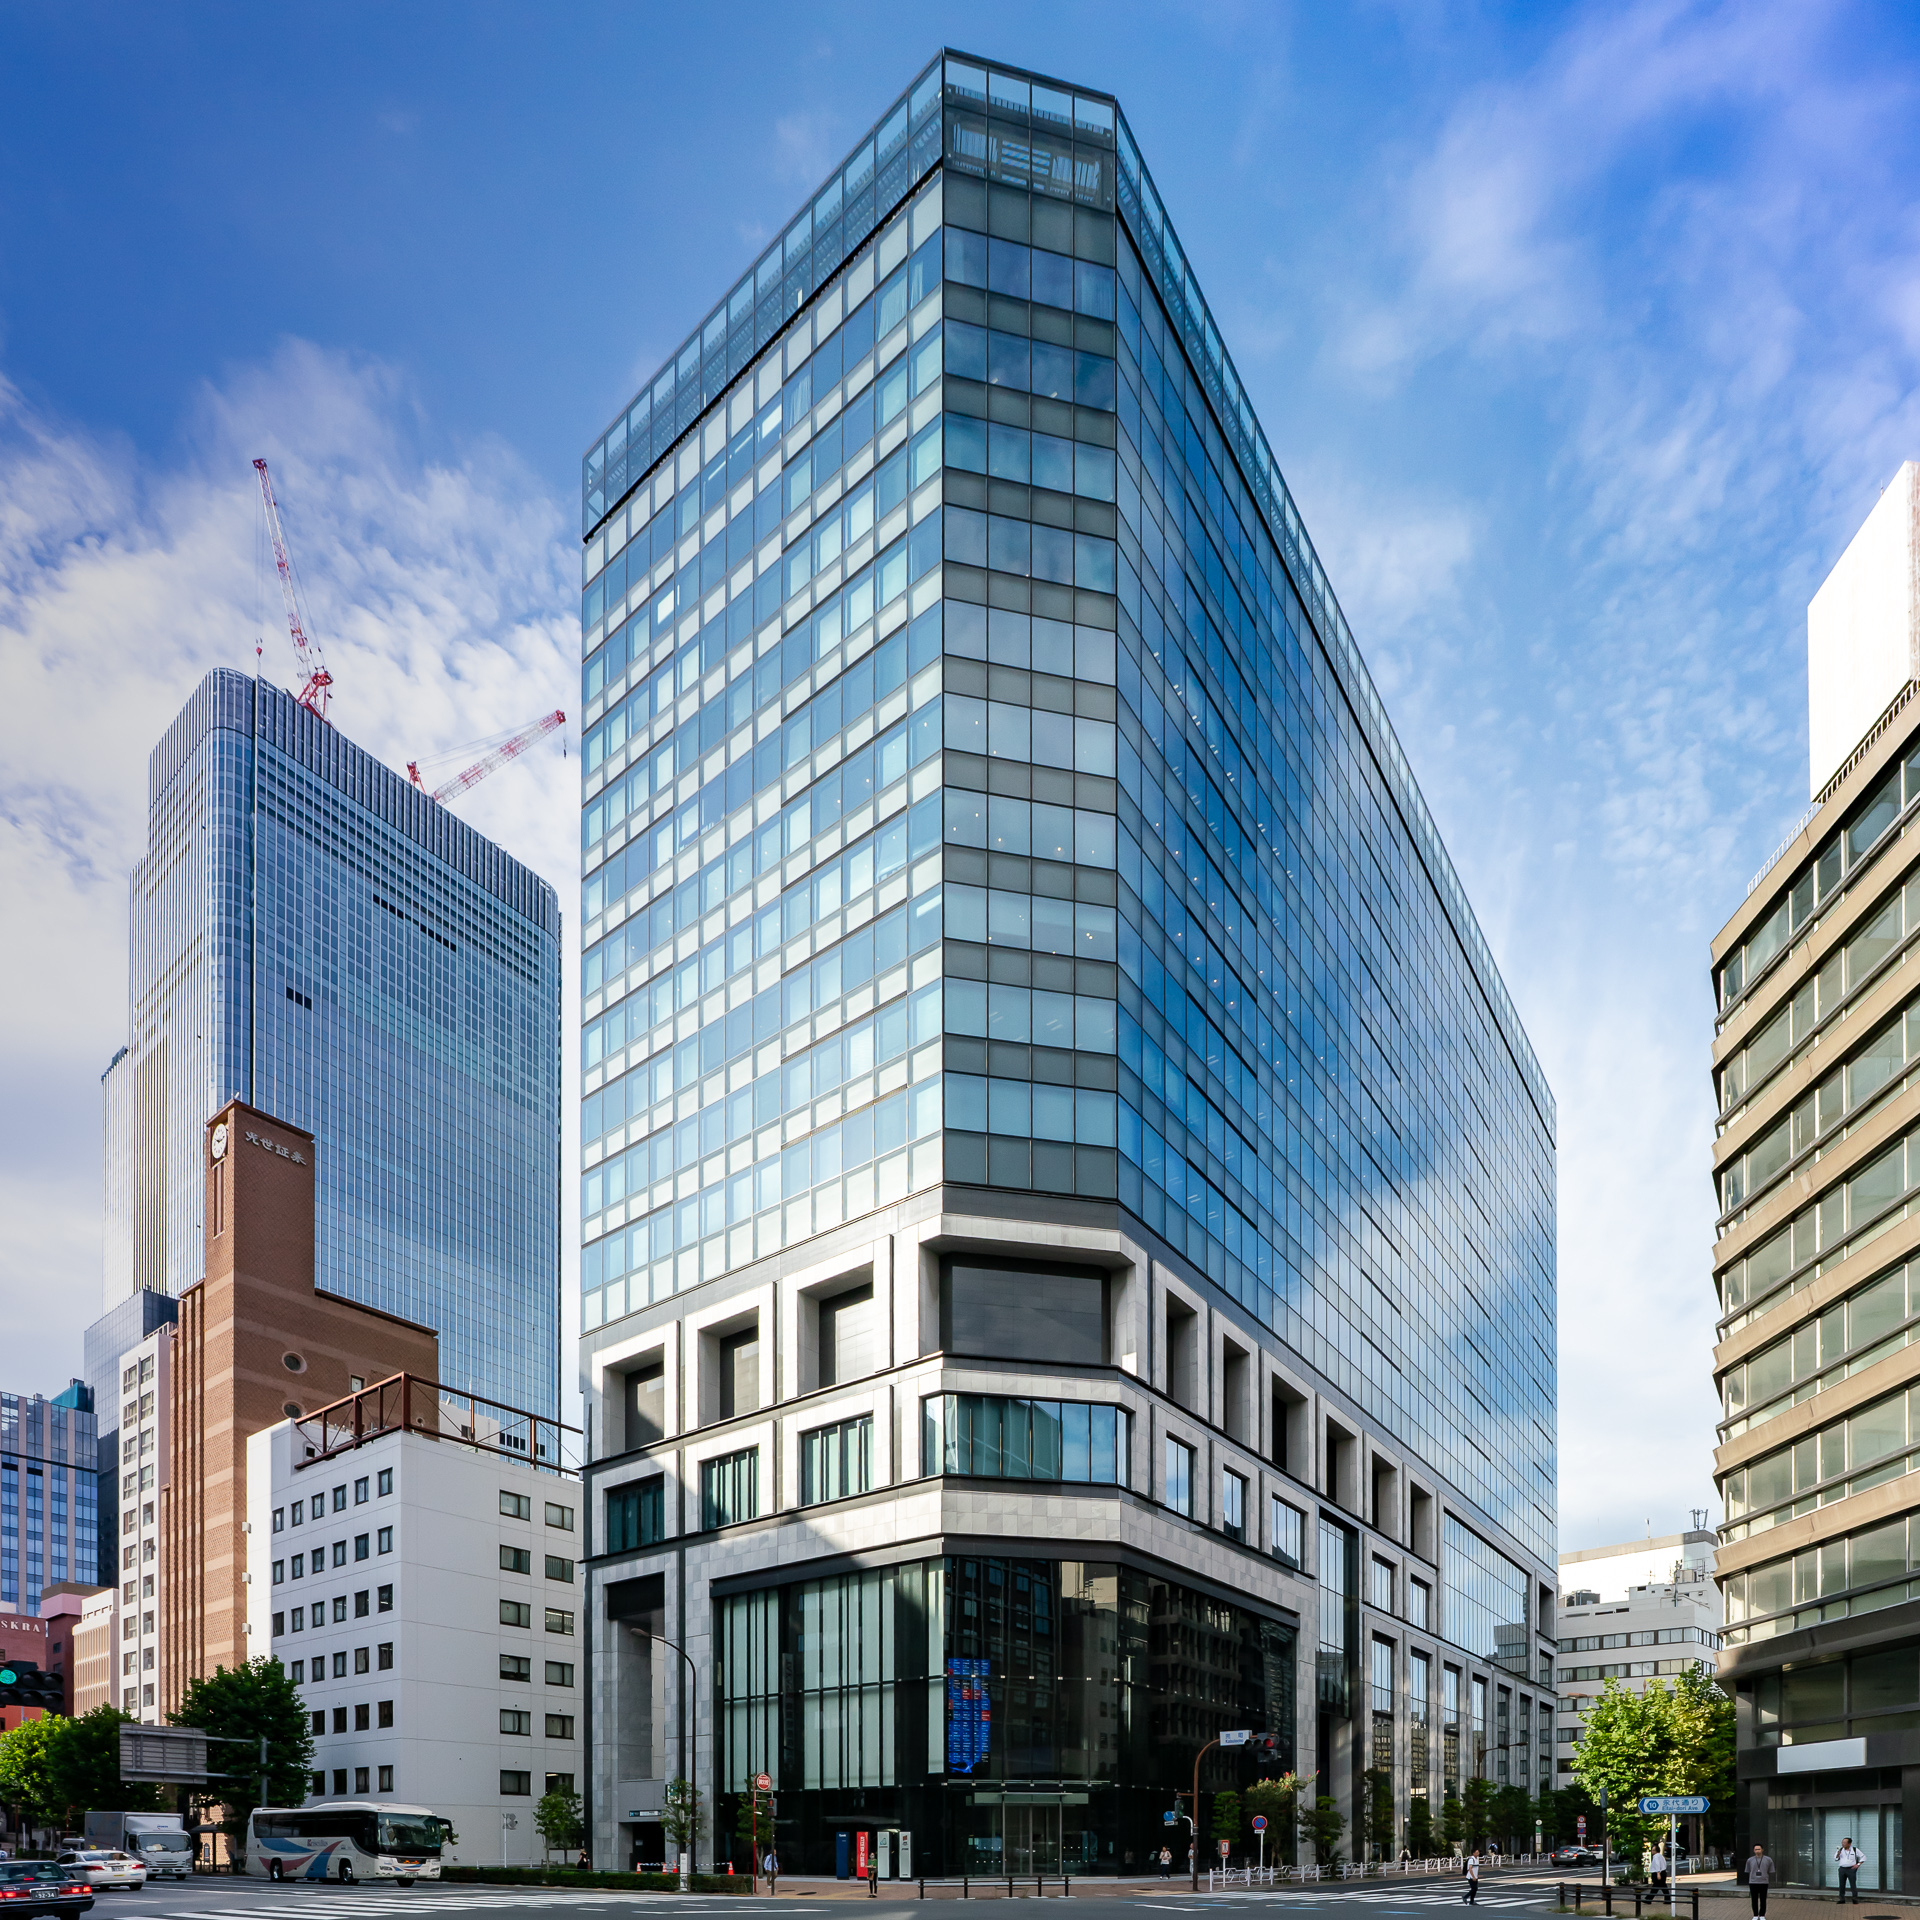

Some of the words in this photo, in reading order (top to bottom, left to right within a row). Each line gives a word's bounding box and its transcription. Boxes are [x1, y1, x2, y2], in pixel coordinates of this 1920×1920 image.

[245, 1131, 307, 1166] 光世証券
[0, 1620, 40, 1633] SKRA
